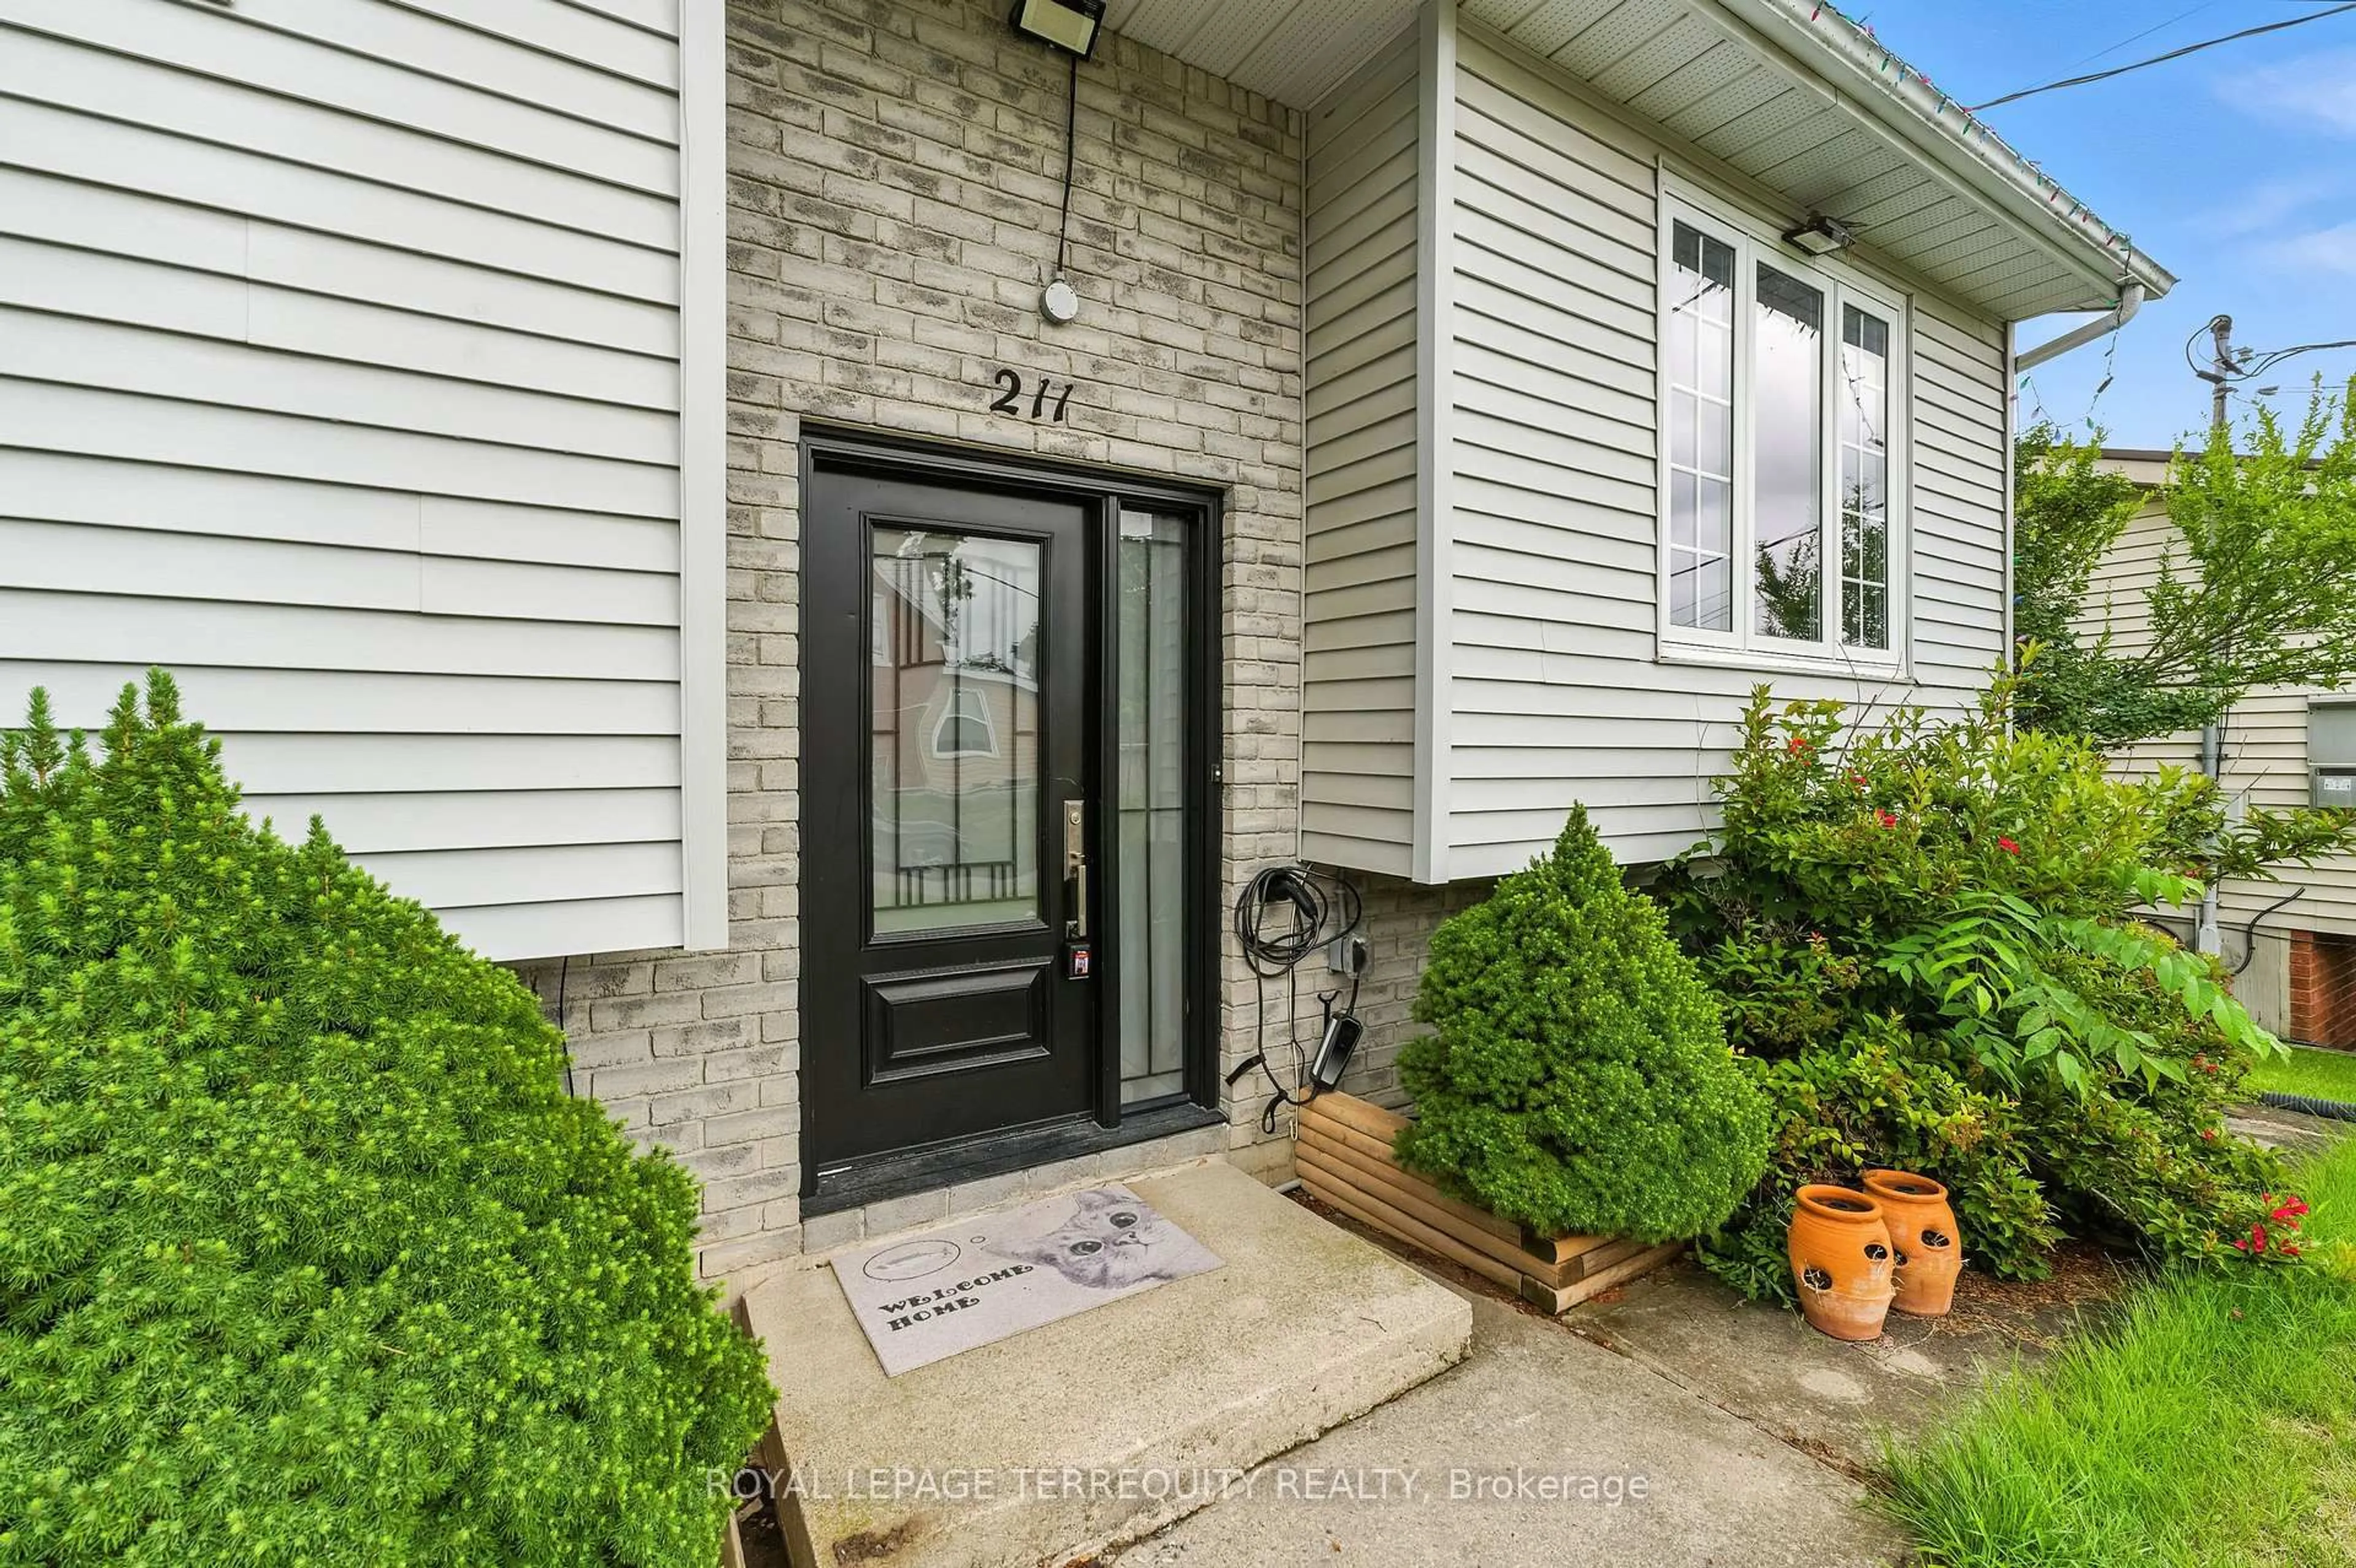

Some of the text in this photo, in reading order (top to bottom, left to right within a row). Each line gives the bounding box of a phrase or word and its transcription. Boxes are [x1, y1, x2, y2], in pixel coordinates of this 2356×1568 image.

[989, 369, 1074, 423] 211
[878, 1264, 1034, 1313] WELCOME
[887, 1296, 980, 1331] HOME
